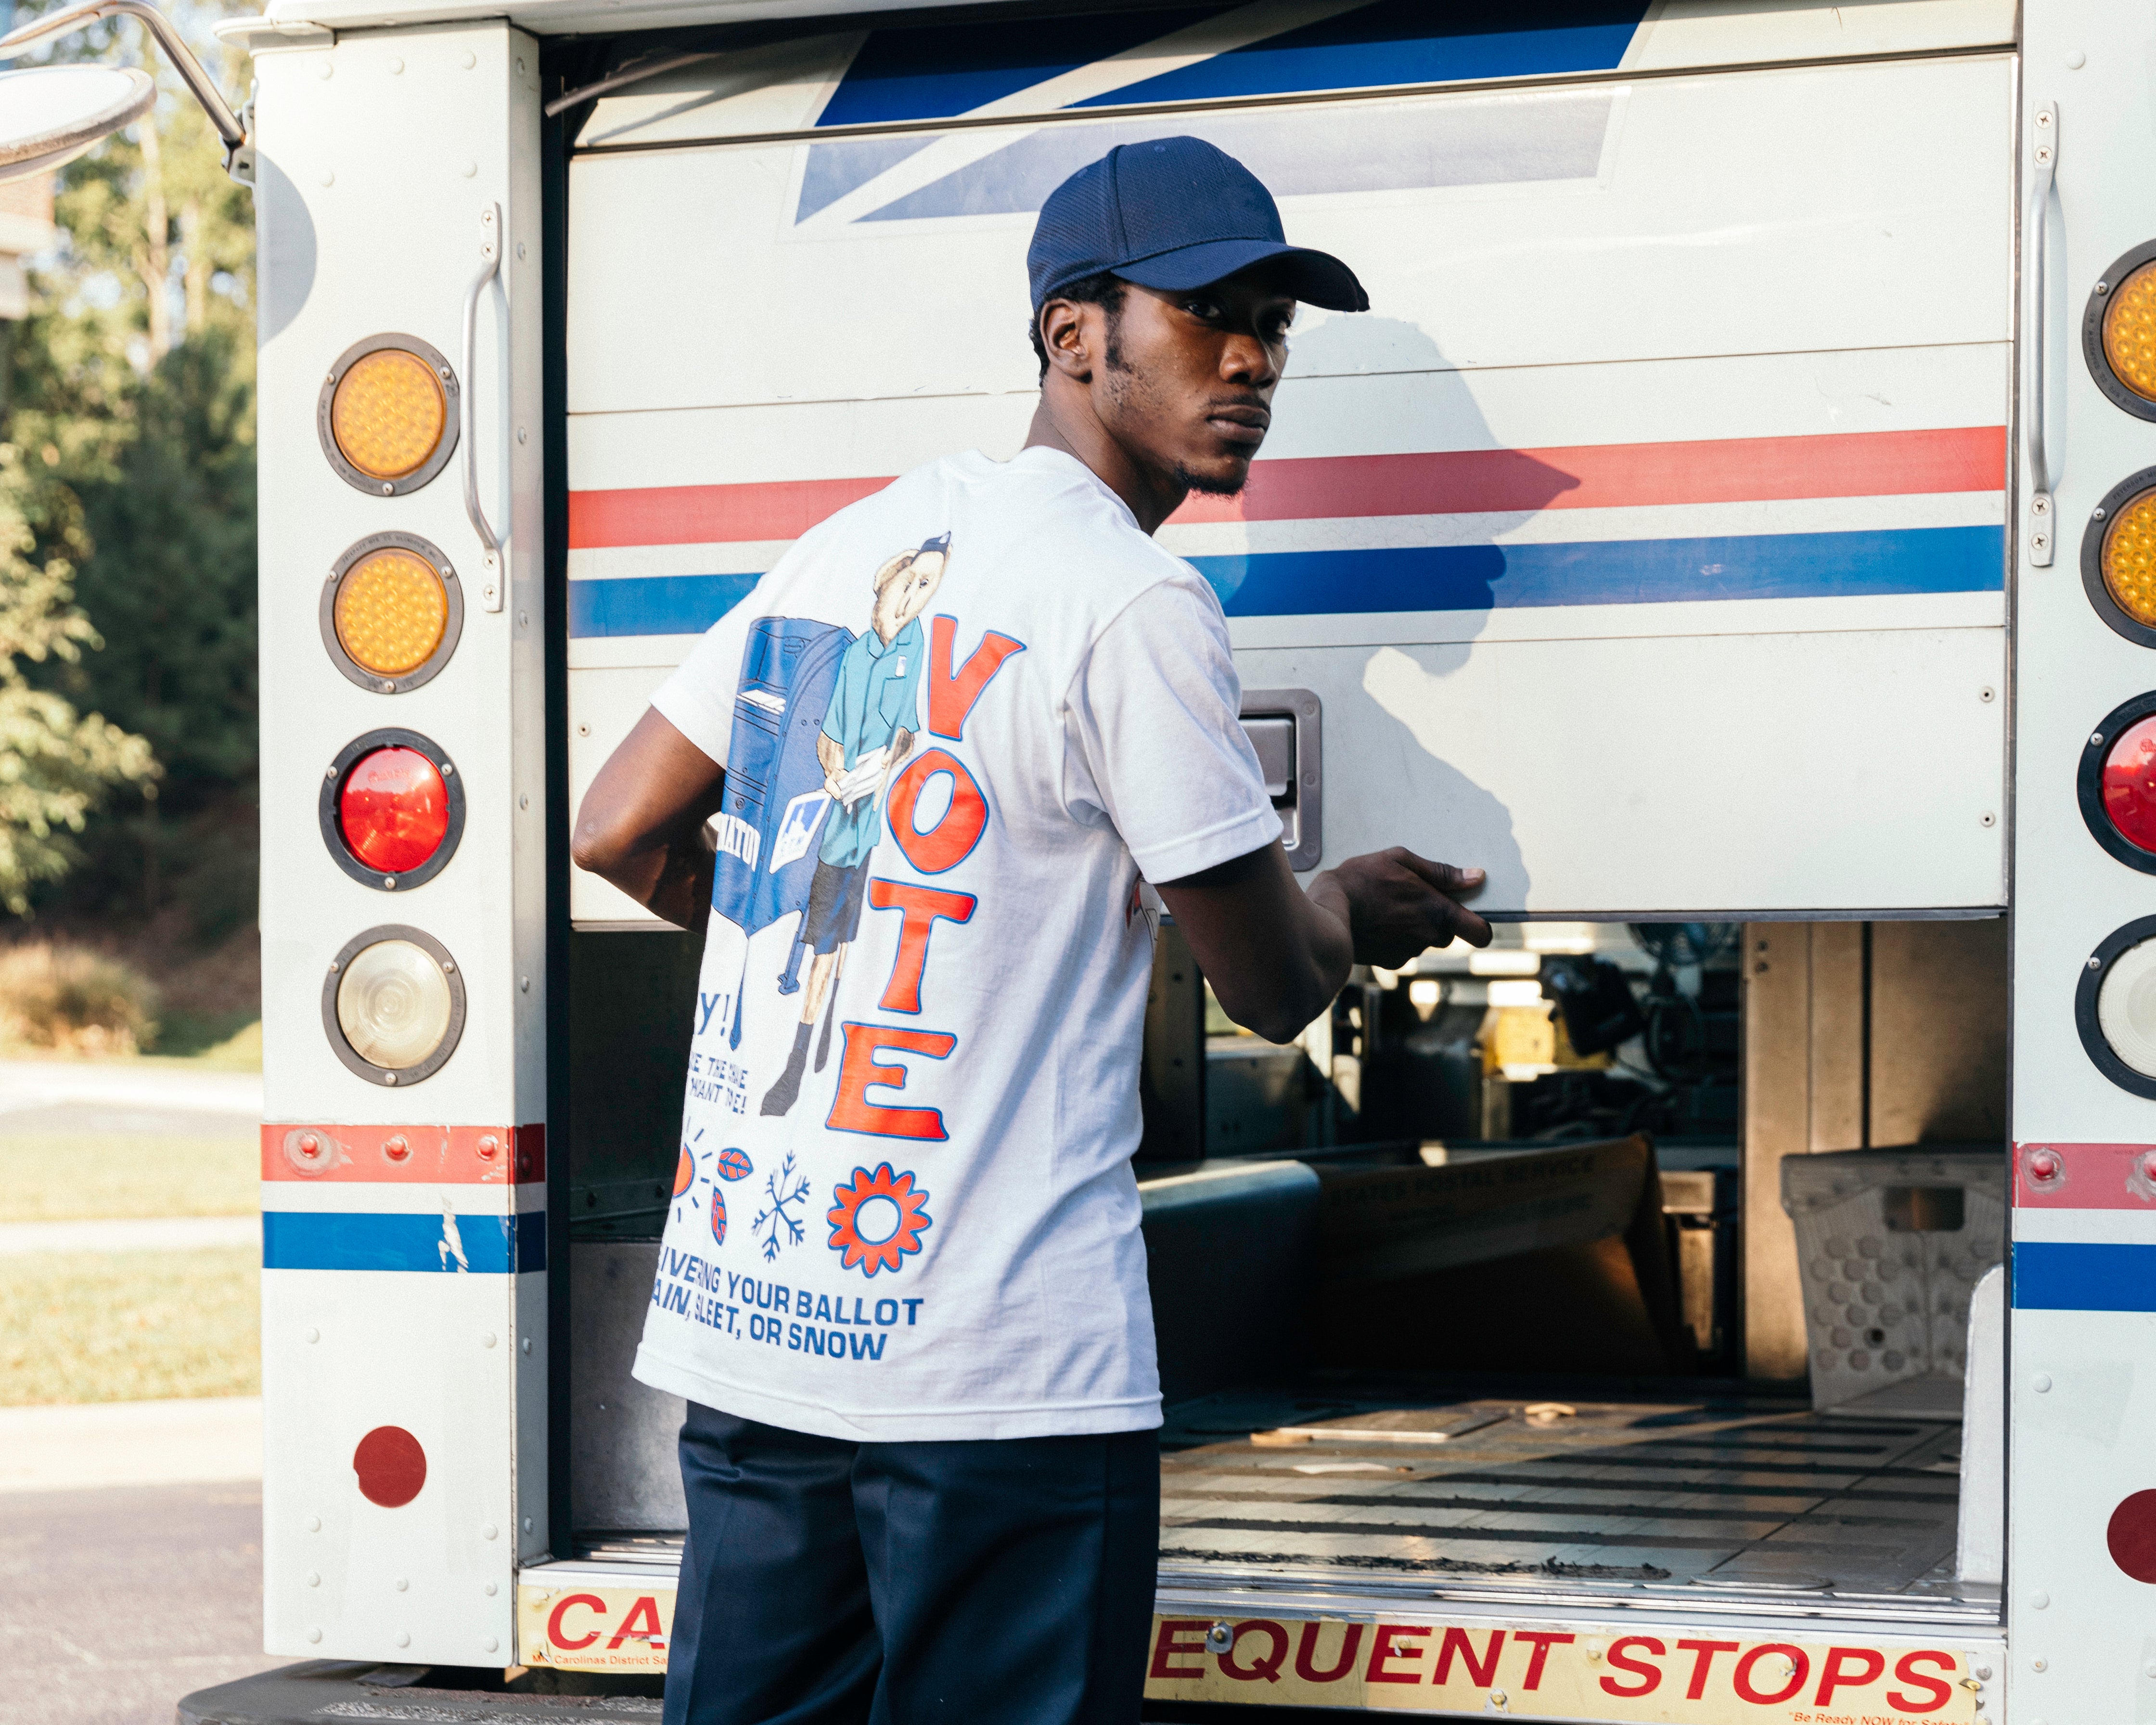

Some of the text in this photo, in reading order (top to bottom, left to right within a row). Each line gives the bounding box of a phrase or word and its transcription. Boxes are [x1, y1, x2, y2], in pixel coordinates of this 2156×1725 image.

[825, 613, 1027, 1143] VOTE
[652, 1278, 692, 1321] AIN,
[750, 1313, 782, 1346] OR
[788, 1322, 888, 1361] SNOW
[728, 1271, 790, 1313] YOUR
[796, 1290, 924, 1326] BALLOT
[547, 1594, 1956, 1713] CA EQUENT STOPS
[554, 1655, 606, 1665] Carolinas
[610, 1655, 650, 1665] District
[652, 1656, 668, 1665] Sa
[1815, 1713, 1857, 1725] Ready
[1861, 1716, 1896, 1725] NOW
